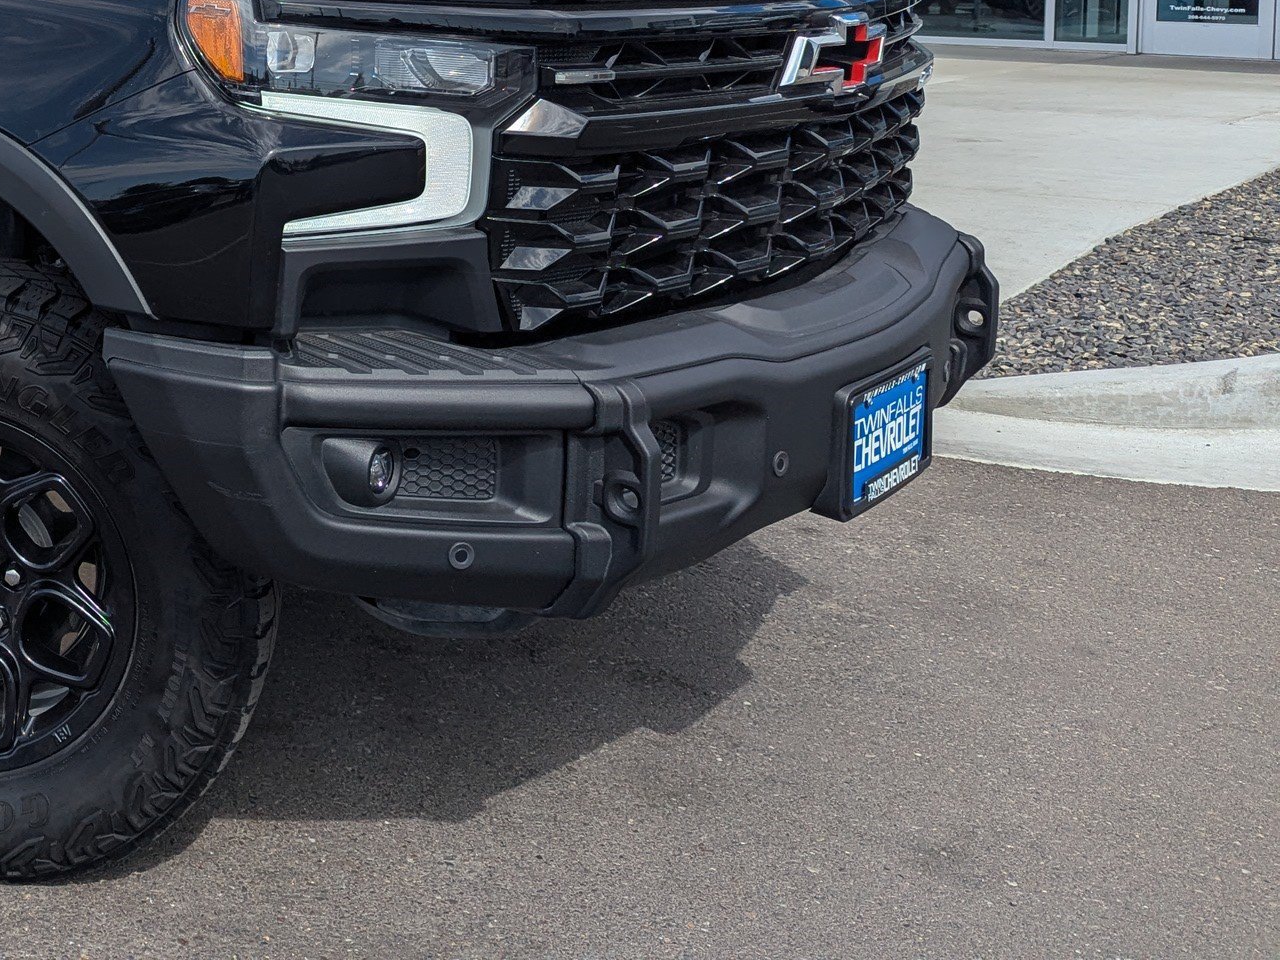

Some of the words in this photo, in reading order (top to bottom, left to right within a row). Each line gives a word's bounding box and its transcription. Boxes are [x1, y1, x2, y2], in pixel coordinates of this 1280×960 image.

[1169, 5, 1246, 13] TwinFalls-Chevy.com
[854, 385, 924, 436] TWINFALLS
[853, 406, 922, 473] CHEVROLET
[883, 454, 920, 492] CHEVROLET
